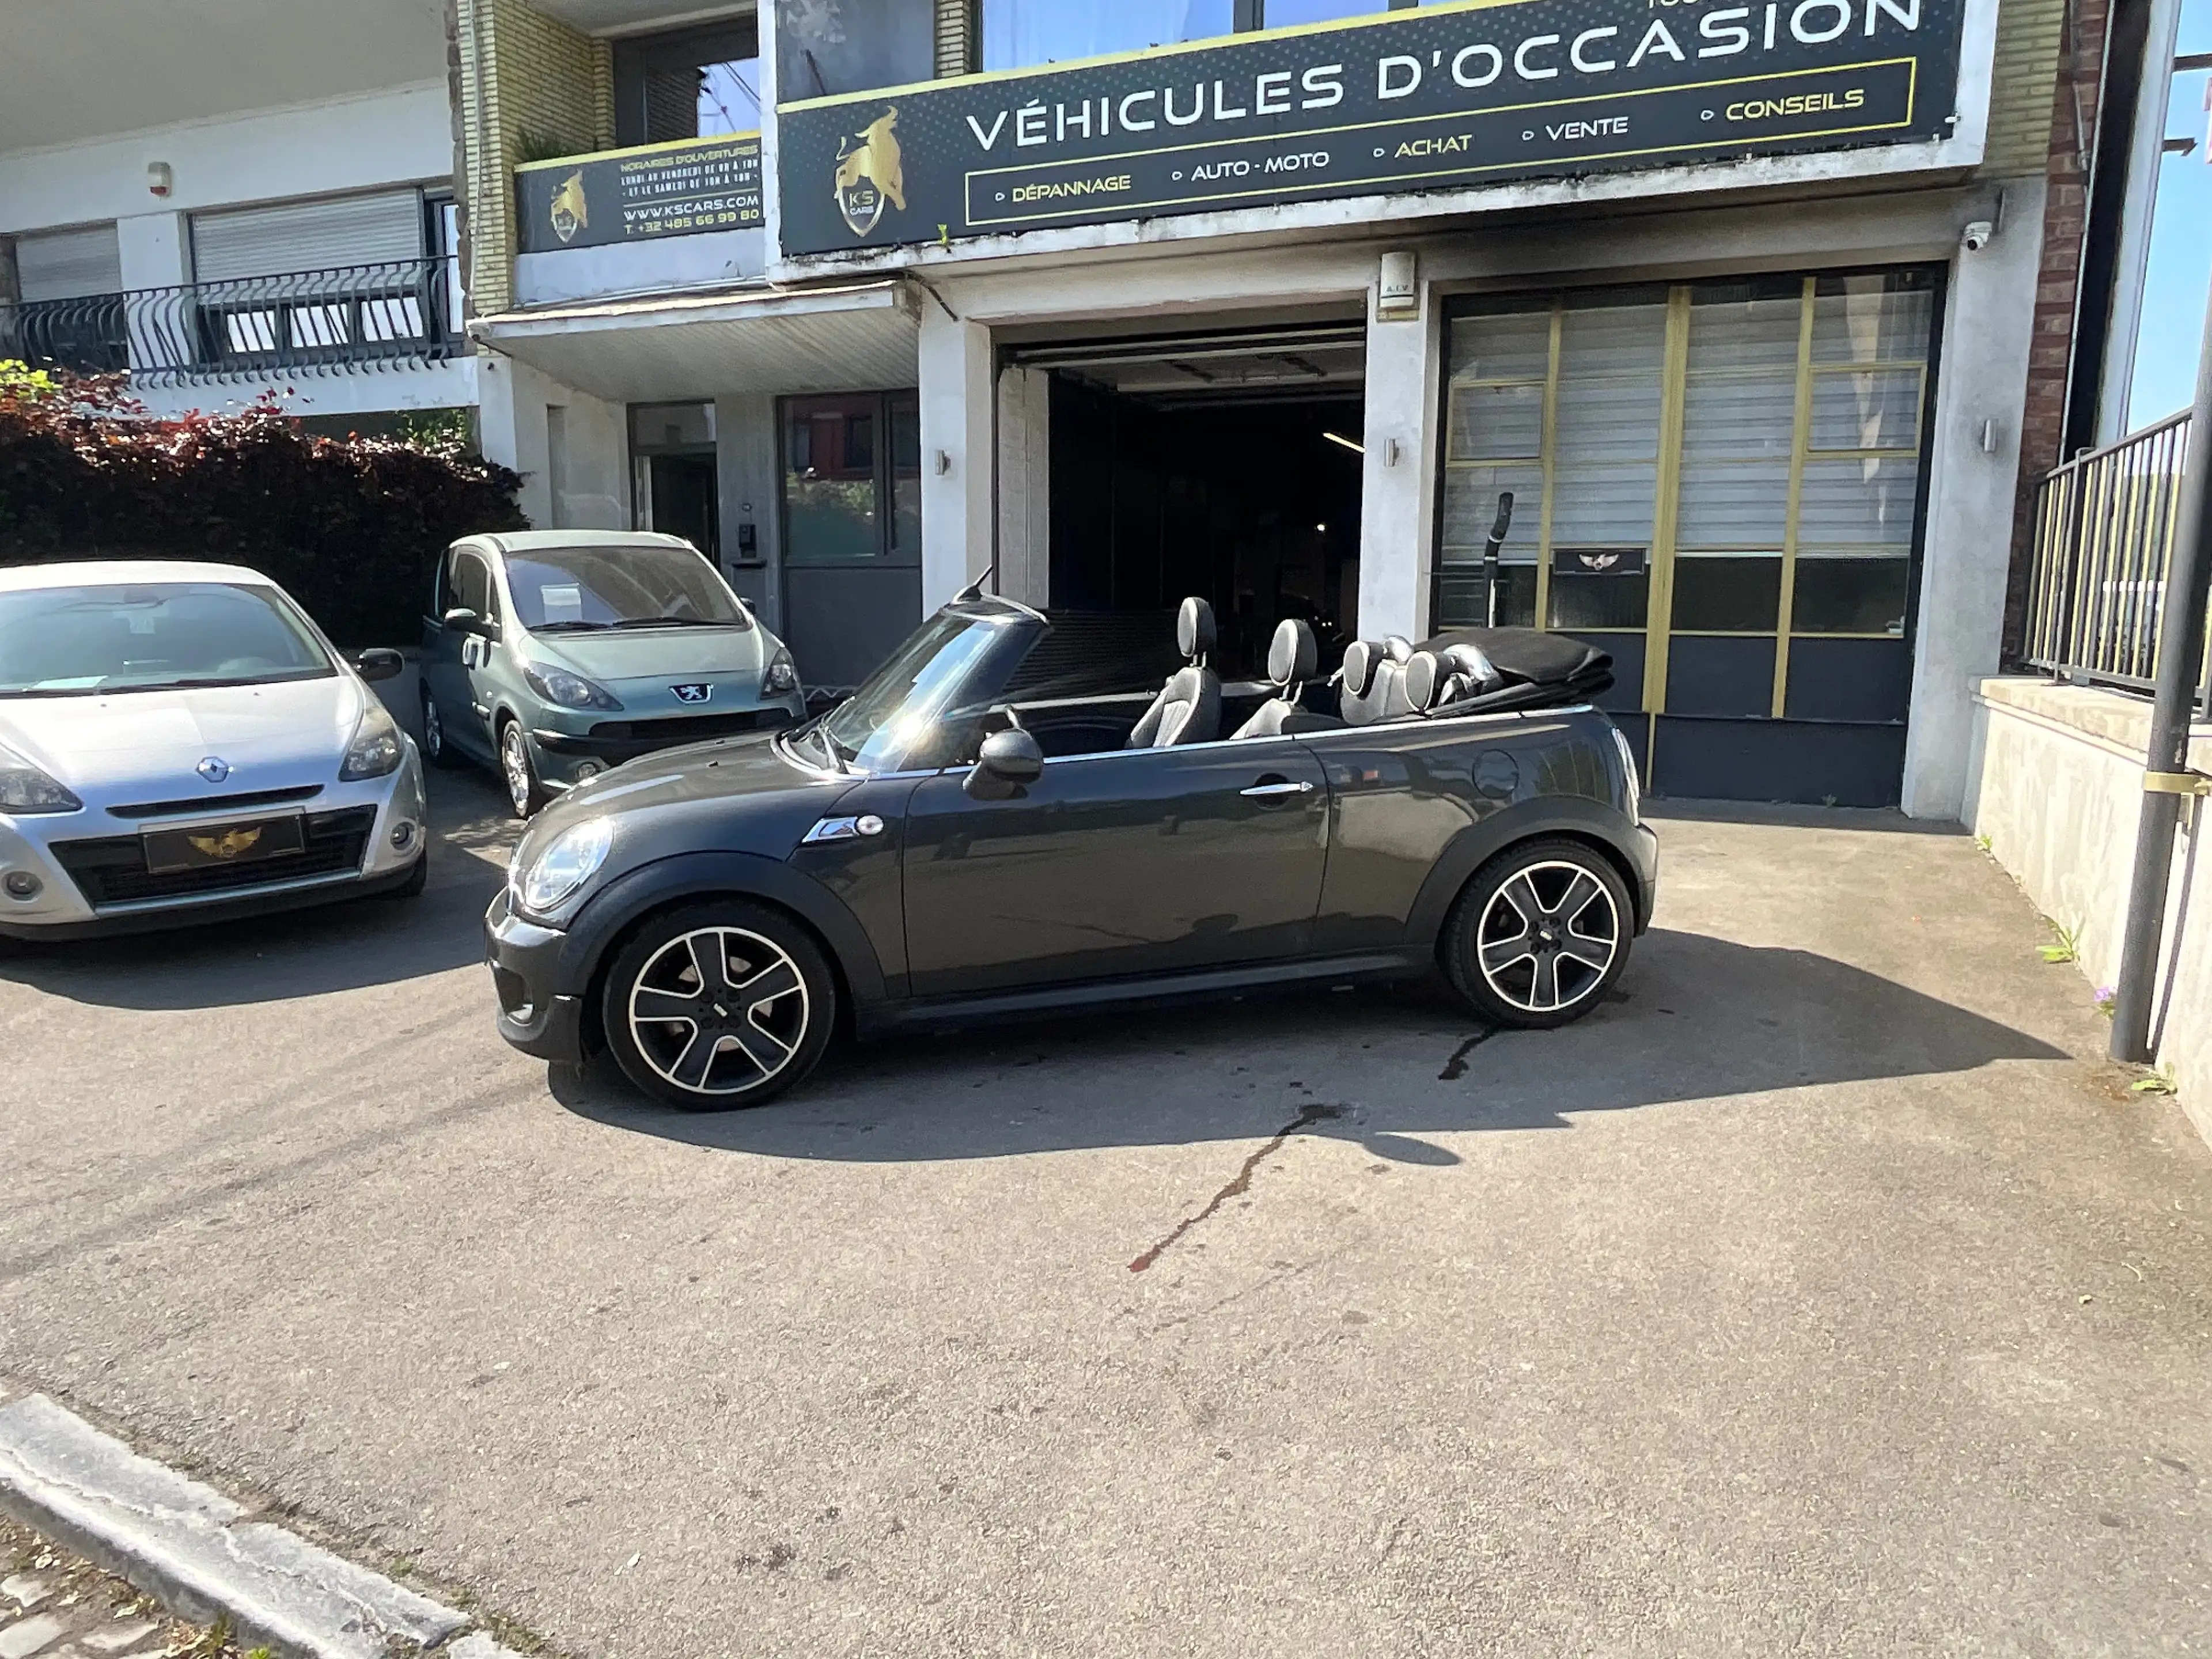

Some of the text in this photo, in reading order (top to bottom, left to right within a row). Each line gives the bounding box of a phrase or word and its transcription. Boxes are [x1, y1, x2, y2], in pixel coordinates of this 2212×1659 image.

[966, 0, 1921, 151] VÉHICULES D'OCCASION
[1012, 175, 1131, 202] DÉPANNAGE
[1394, 135, 1472, 158] ACHAT
[1545, 116, 1628, 141] VENTE
[1726, 89, 1865, 120] CONSEILS
[623, 195, 759, 221] WWW.KSCARS.COM
[665, 217, 692, 229] 485
[695, 214, 714, 226] 66
